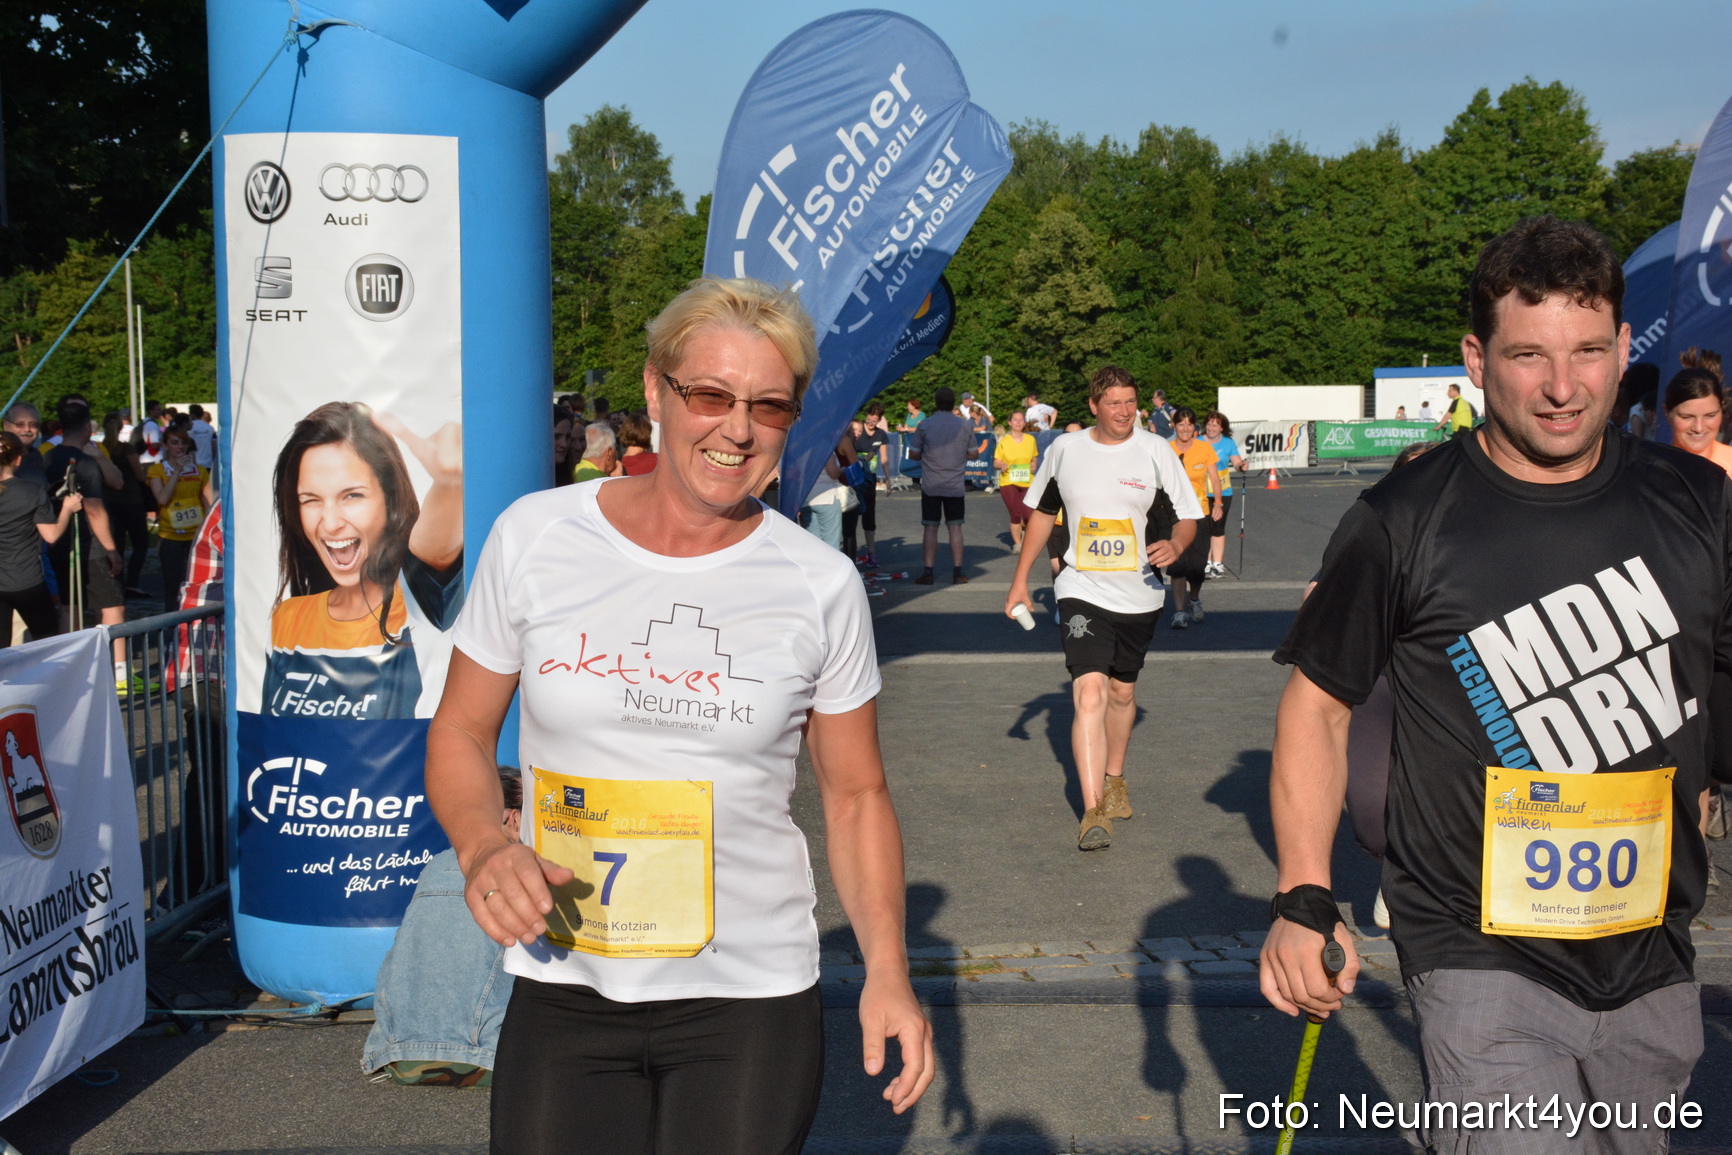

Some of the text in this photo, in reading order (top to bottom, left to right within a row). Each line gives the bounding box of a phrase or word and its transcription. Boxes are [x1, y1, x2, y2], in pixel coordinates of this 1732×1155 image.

[768, 62, 911, 271] Fischer
[817, 104, 928, 269] AUTOMOBILE
[323, 213, 369, 227] Audi
[885, 165, 976, 302] AUTOMOBILE
[361, 274, 399, 302] FIAT
[245, 310, 308, 322] SEAT
[916, 313, 946, 341] Medien
[1245, 433, 1284, 454] swn
[1322, 427, 1355, 445] AOK
[1011, 470, 1029, 478] 1286
[175, 508, 197, 521] 913
[1088, 540, 1125, 556] 409
[1468, 555, 1680, 710] MDN
[539, 632, 720, 696] aktives
[280, 690, 378, 720] Fischer
[624, 688, 755, 724] Neumarkt
[1512, 642, 1698, 774] DRV.
[621, 713, 716, 733] aktives Neumarkt e.V.
[268, 785, 424, 819] Fischer
[555, 801, 609, 822] firmenlauf
[1517, 798, 1587, 813] firmenlauf
[611, 817, 647, 830] 2016
[1497, 816, 1551, 831] walken
[1588, 808, 1622, 820] 2016
[29, 820, 54, 846] 1628
[280, 822, 410, 838] AUTOMOBILE
[543, 820, 581, 838] walken
[303, 857, 335, 875] und
[339, 853, 373, 871] das
[1524, 838, 1638, 893] 980
[344, 875, 395, 898] fährt
[593, 851, 627, 906] 7
[0, 865, 113, 955] Neumarkter
[1531, 901, 1628, 915] Manfred Blomeier
[576, 914, 657, 932] Simone Kotzian
[1534, 917, 1558, 925] Modern
[1577, 917, 1607, 926] Technology
[1608, 914, 1624, 922] GmbH
[583, 931, 599, 941] aktives
